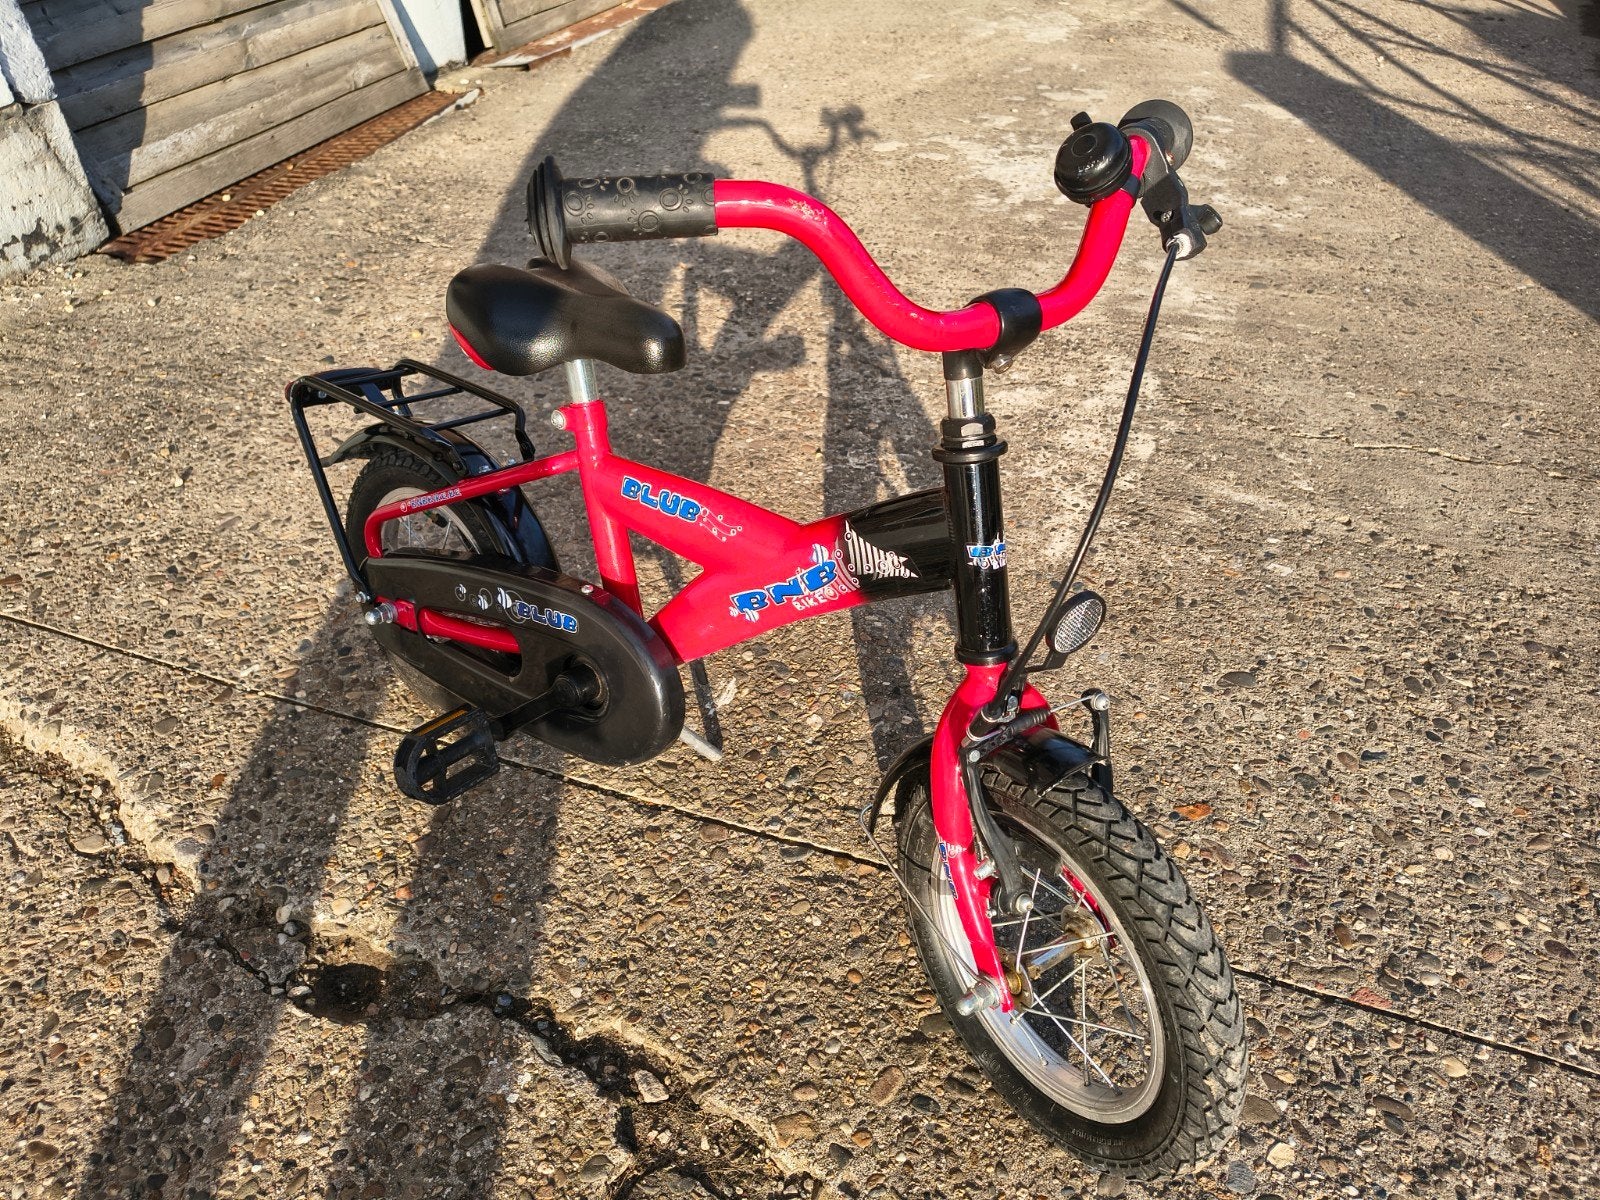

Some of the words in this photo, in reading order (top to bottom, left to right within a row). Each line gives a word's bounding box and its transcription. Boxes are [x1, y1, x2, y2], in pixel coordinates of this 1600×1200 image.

[621, 475, 702, 522] BLUB
[729, 560, 838, 613] BNB
[516, 600, 578, 633] BLUB
